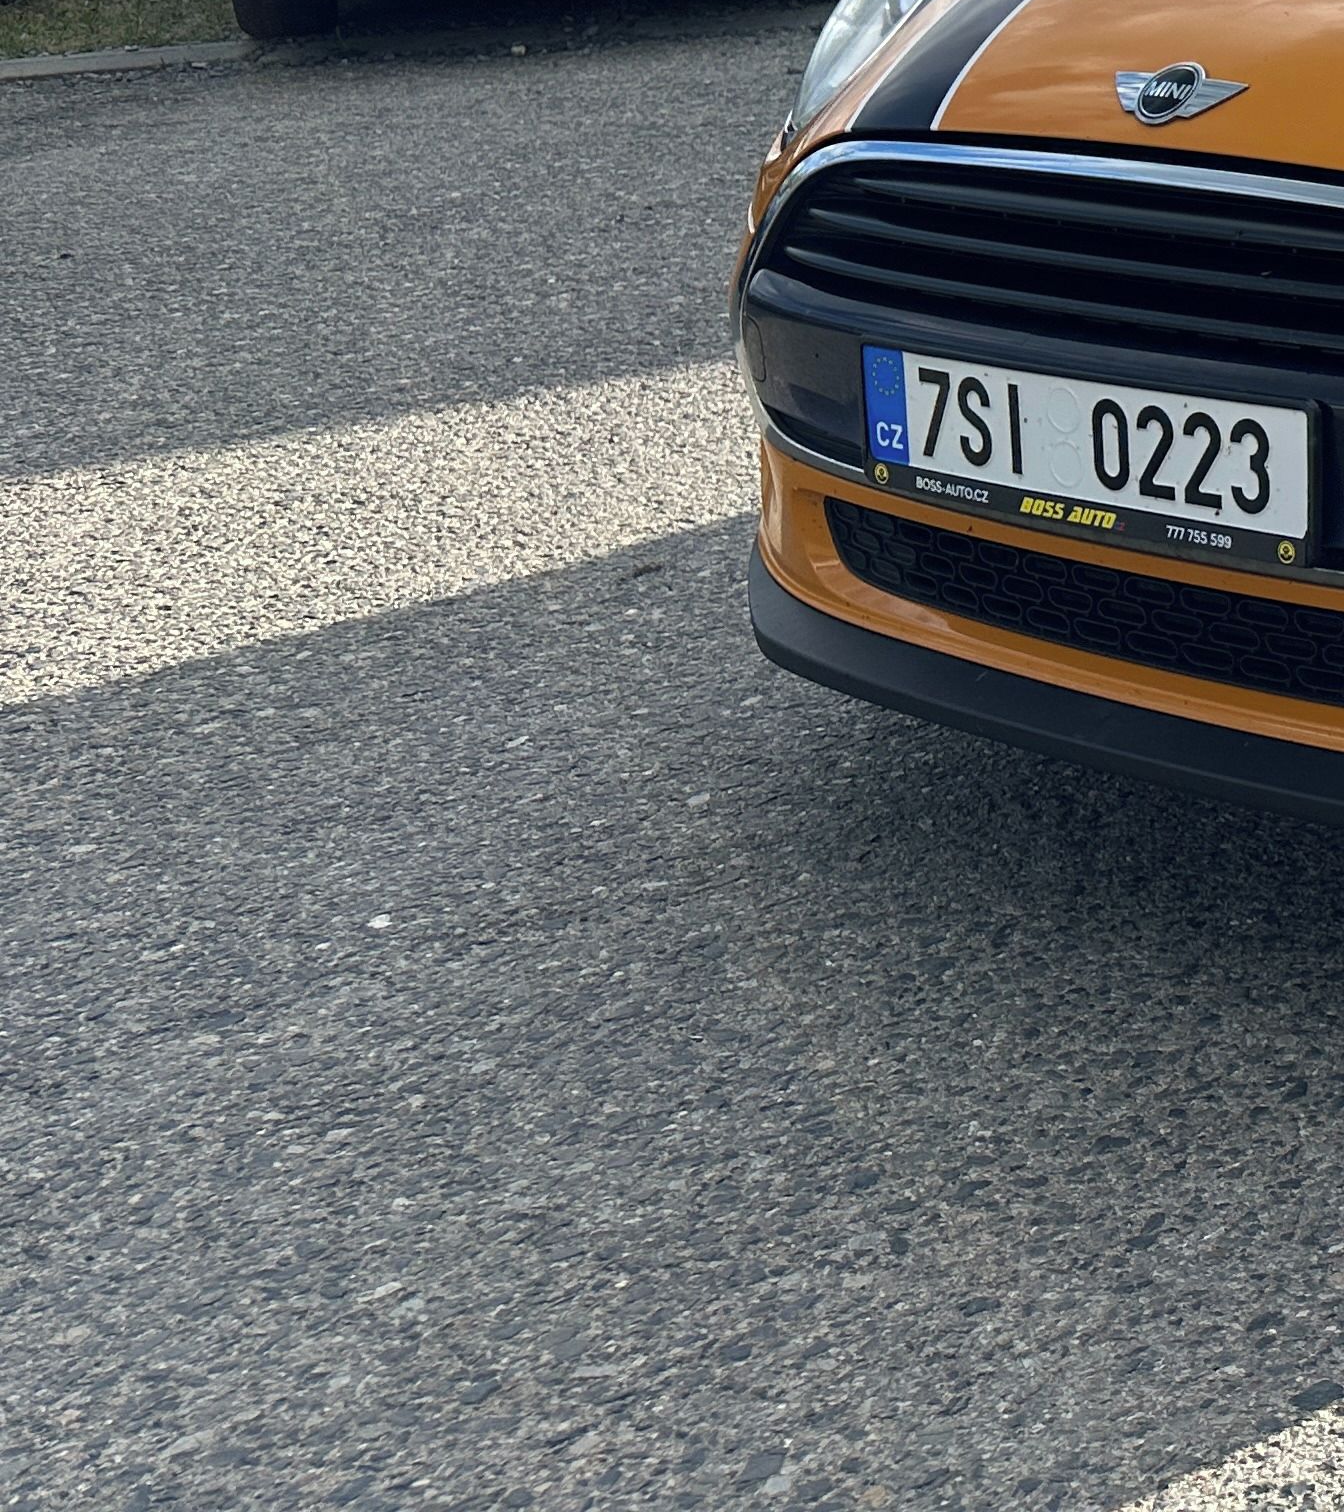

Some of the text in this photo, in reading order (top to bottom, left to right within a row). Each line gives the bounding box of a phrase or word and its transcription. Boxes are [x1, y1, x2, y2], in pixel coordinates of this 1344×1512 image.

[1144, 81, 1193, 101] MINI
[876, 366, 1271, 516] CZ 7SI 0223
[915, 476, 990, 504] BOSS-AUTO.CZ
[1019, 496, 1066, 521] BOSS
[1066, 504, 1117, 530] AUTO
[1166, 524, 1232, 549] 777 755 599
